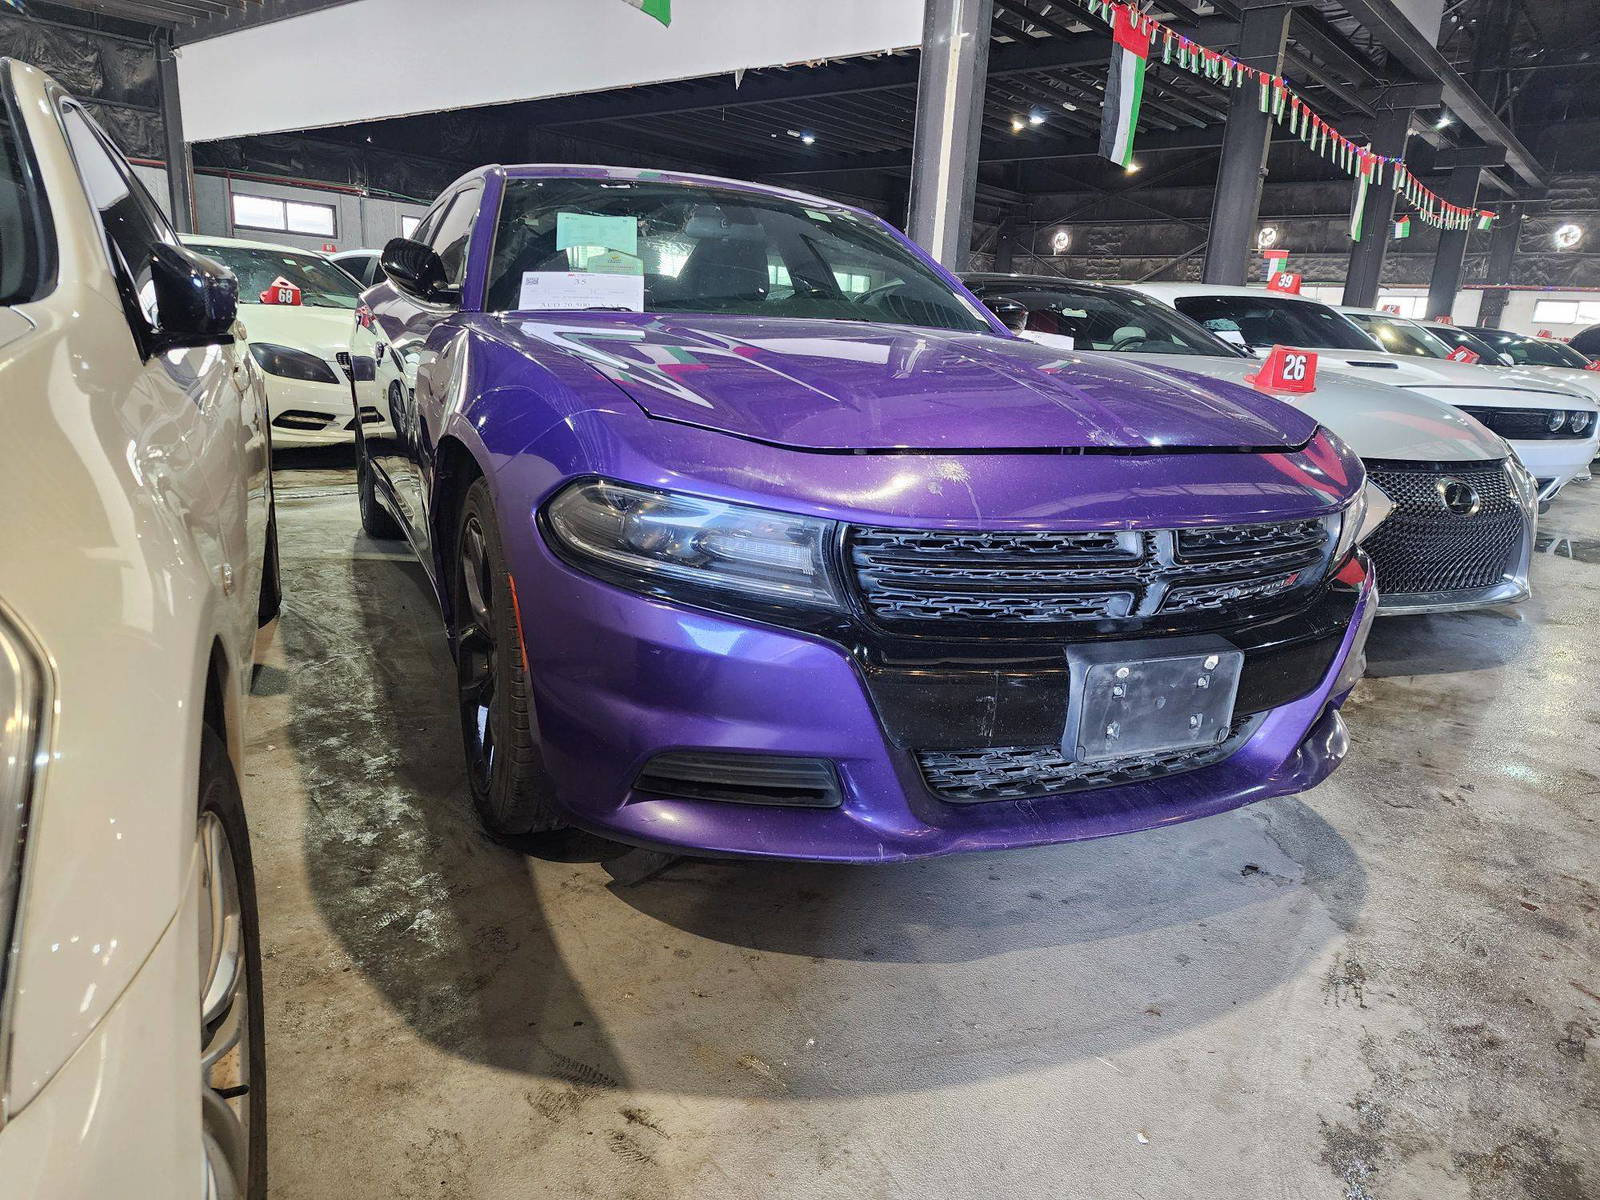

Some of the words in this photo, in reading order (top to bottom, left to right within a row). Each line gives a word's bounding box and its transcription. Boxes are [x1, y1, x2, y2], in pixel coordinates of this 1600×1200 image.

[1278, 273, 1294, 289] 39
[278, 288, 293, 304] 68
[1282, 354, 1307, 380] 26
